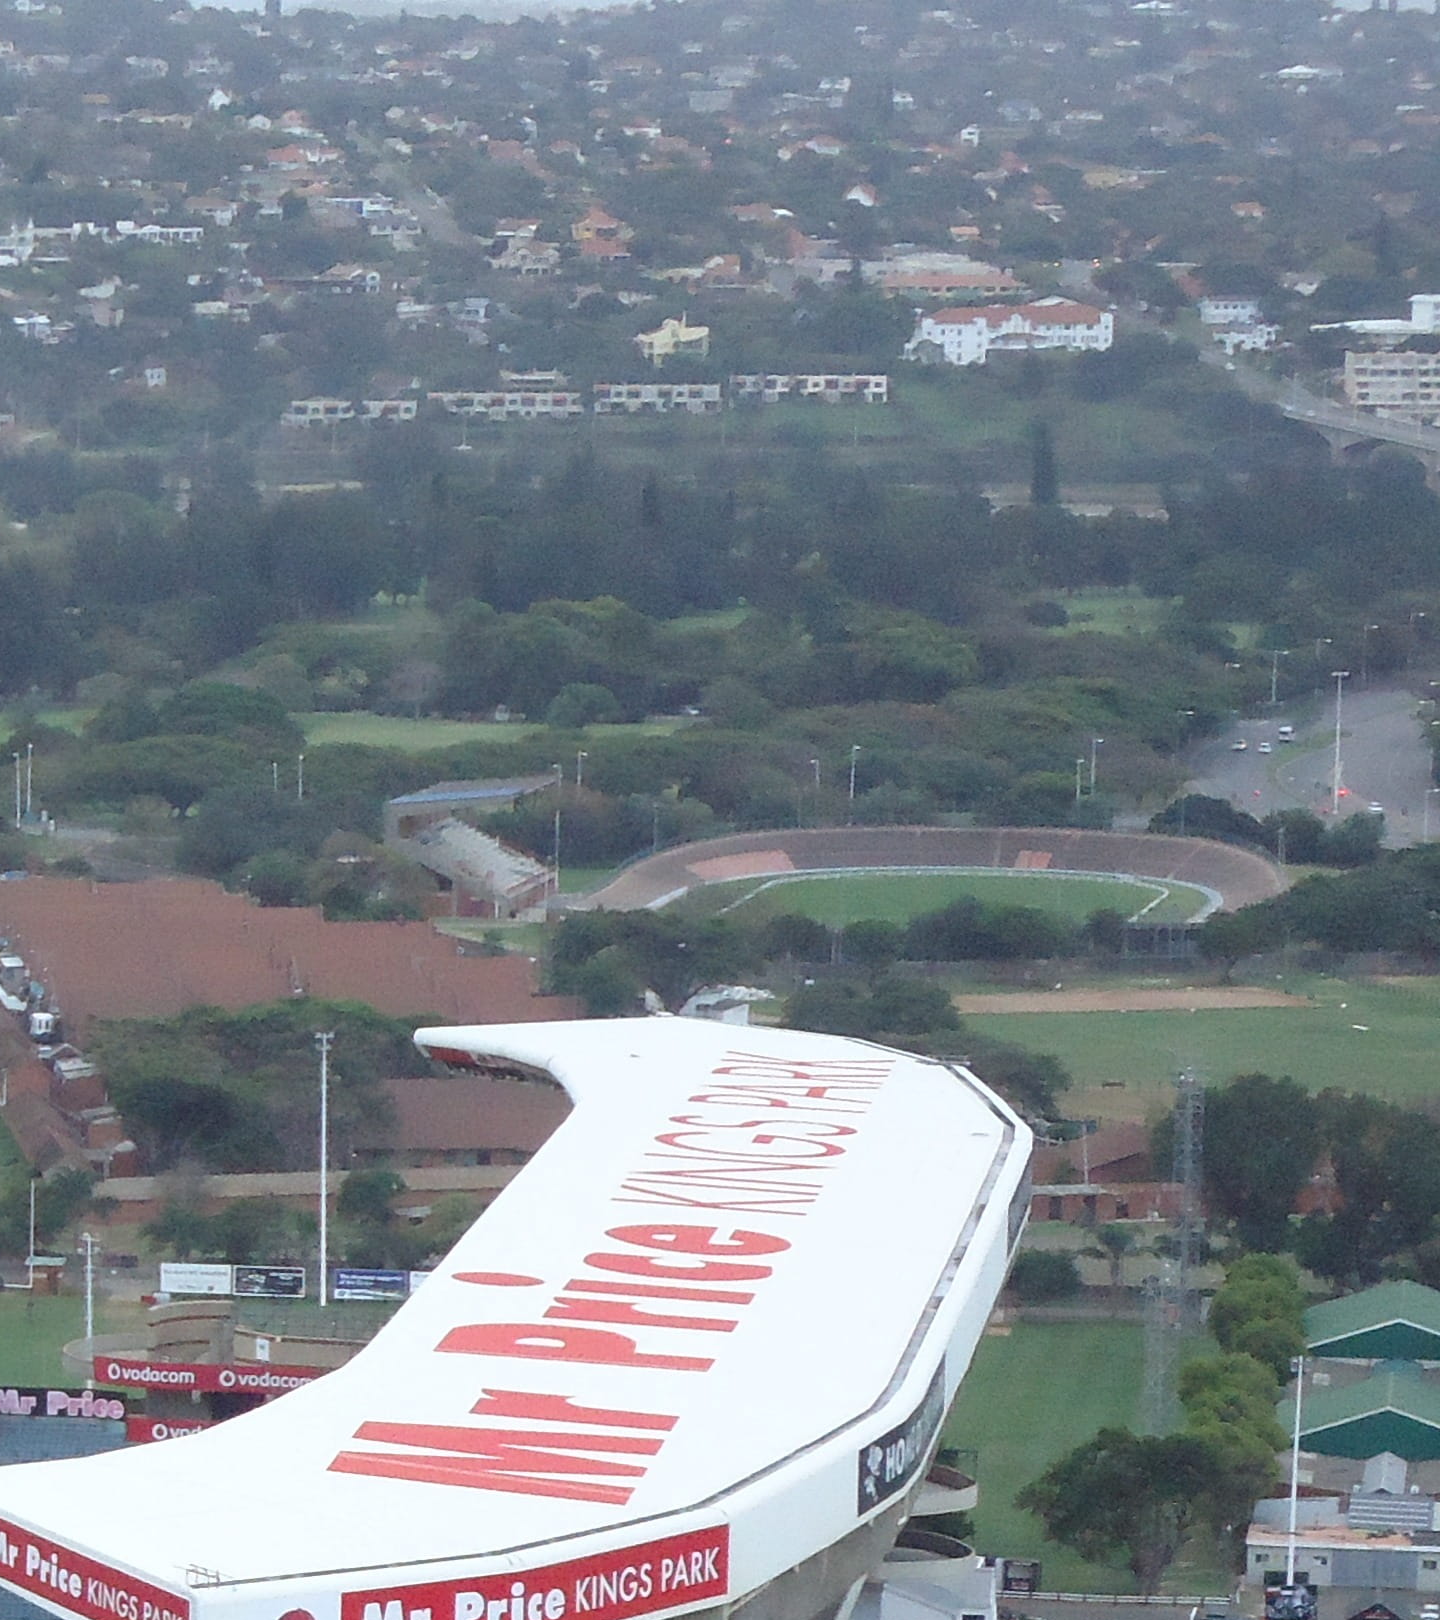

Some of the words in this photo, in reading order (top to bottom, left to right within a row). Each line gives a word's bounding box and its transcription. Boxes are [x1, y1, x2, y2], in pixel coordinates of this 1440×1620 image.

[433, 1222, 793, 1372] Price
[46, 1390, 125, 1420] Price
[122, 1366, 195, 1385] vodacom
[326, 1387, 681, 1506] Mr
[25, 1544, 82, 1598] Price
[575, 1562, 653, 1614] KINGS
[661, 1546, 720, 1593] PARK
